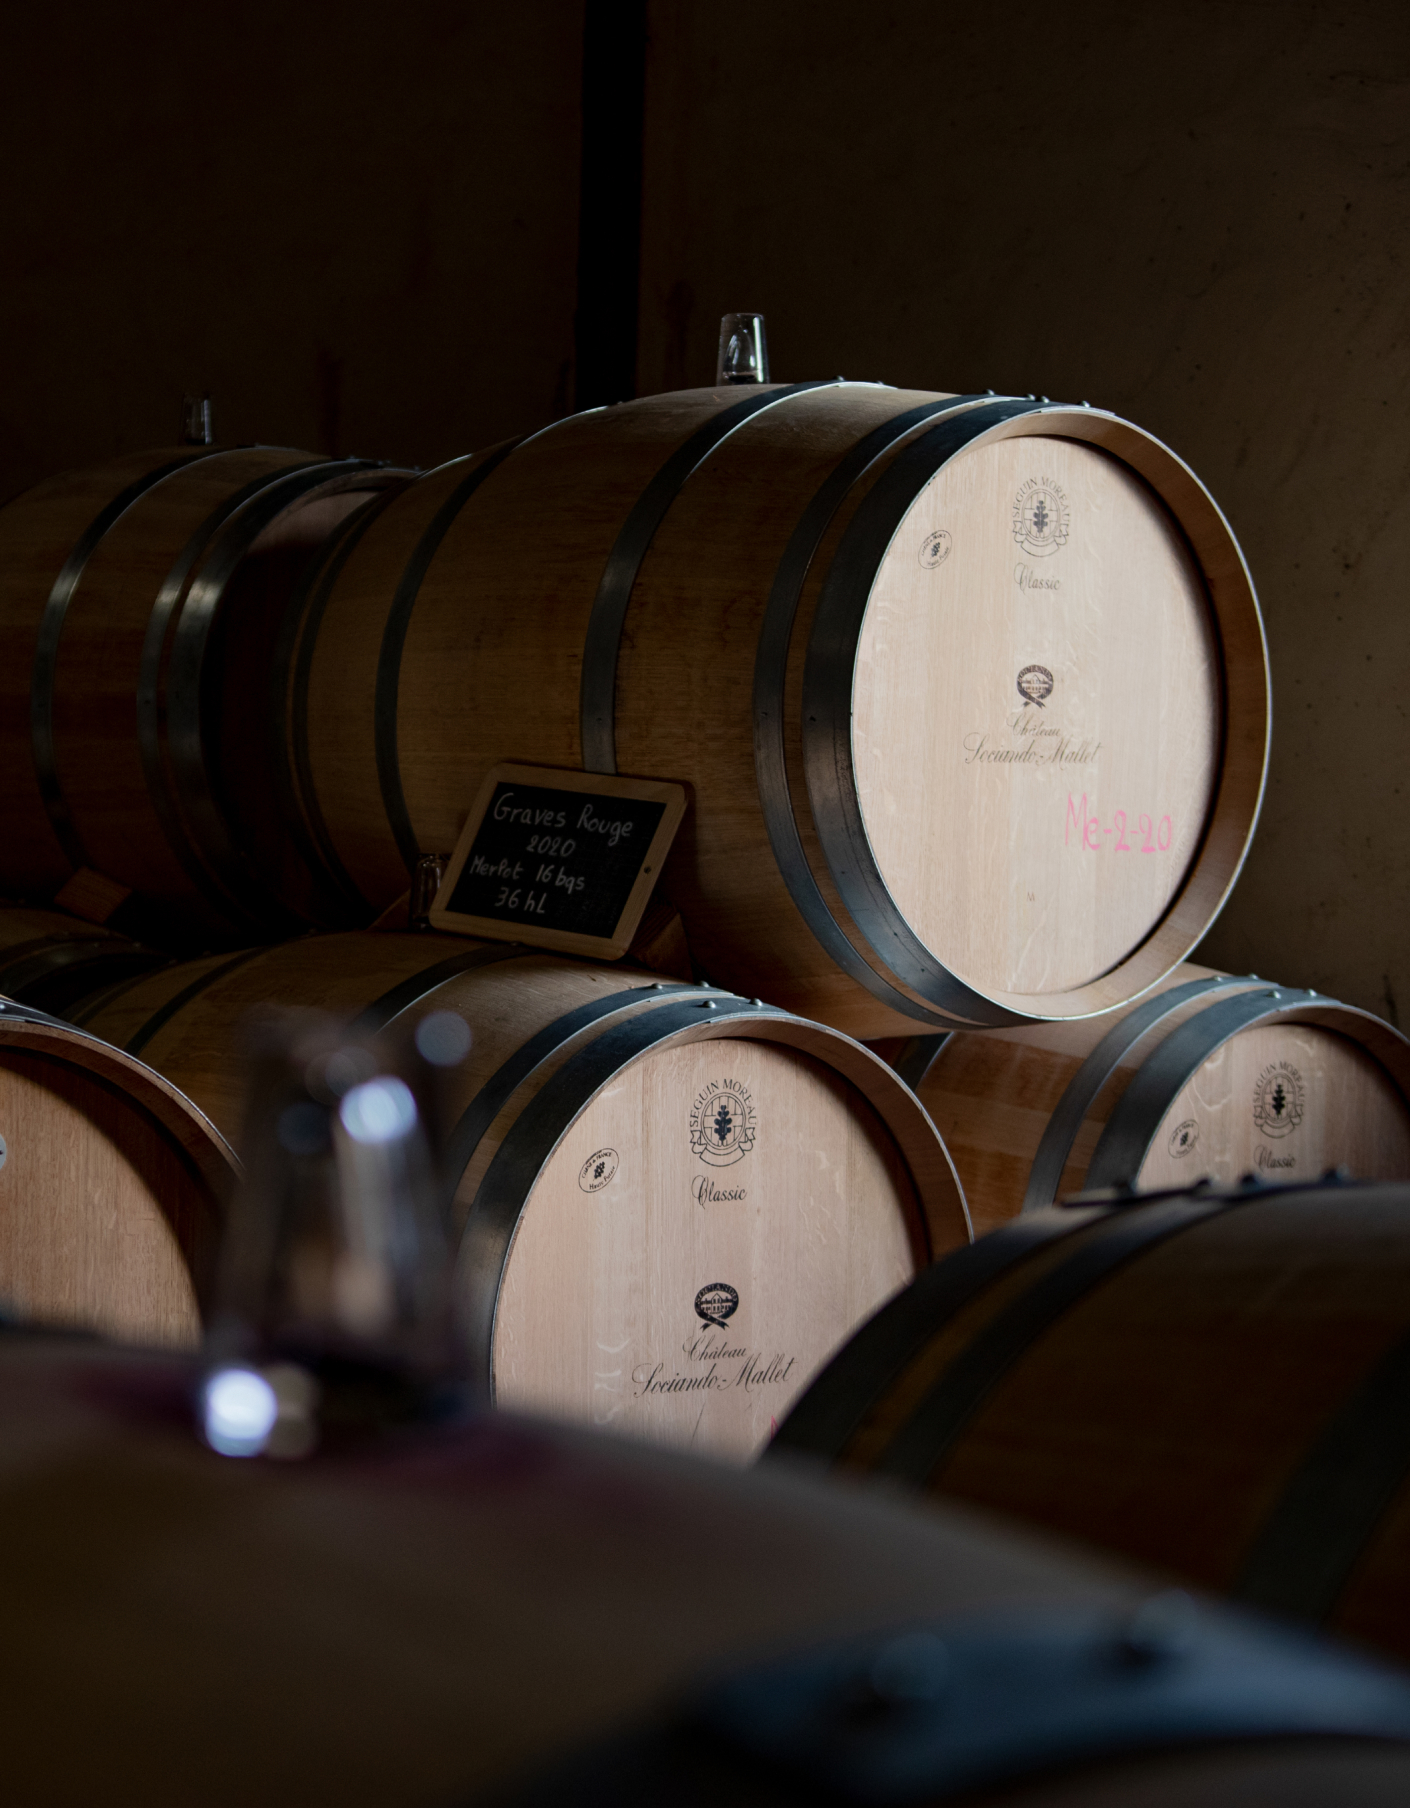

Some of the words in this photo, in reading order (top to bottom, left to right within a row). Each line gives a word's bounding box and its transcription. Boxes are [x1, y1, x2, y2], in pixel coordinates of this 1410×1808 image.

[1012, 477, 1038, 519] SEGUIN
[1041, 476, 1070, 522] MOREAU
[1013, 562, 1061, 595] Classic
[1006, 711, 1061, 737] Château
[493, 792, 567, 828] Graves
[576, 804, 634, 847] Rouge
[526, 834, 576, 858] 2020
[469, 855, 524, 880] Merlot
[494, 886, 522, 909] 36
[690, 1080, 719, 1128] SEGUIN
[722, 1078, 757, 1126] MOREAU
[1253, 1144, 1297, 1173] Classic
[691, 1174, 747, 1210] Classic
[682, 1334, 748, 1362] Château
[631, 1351, 798, 1399] Sociando-Mallet
